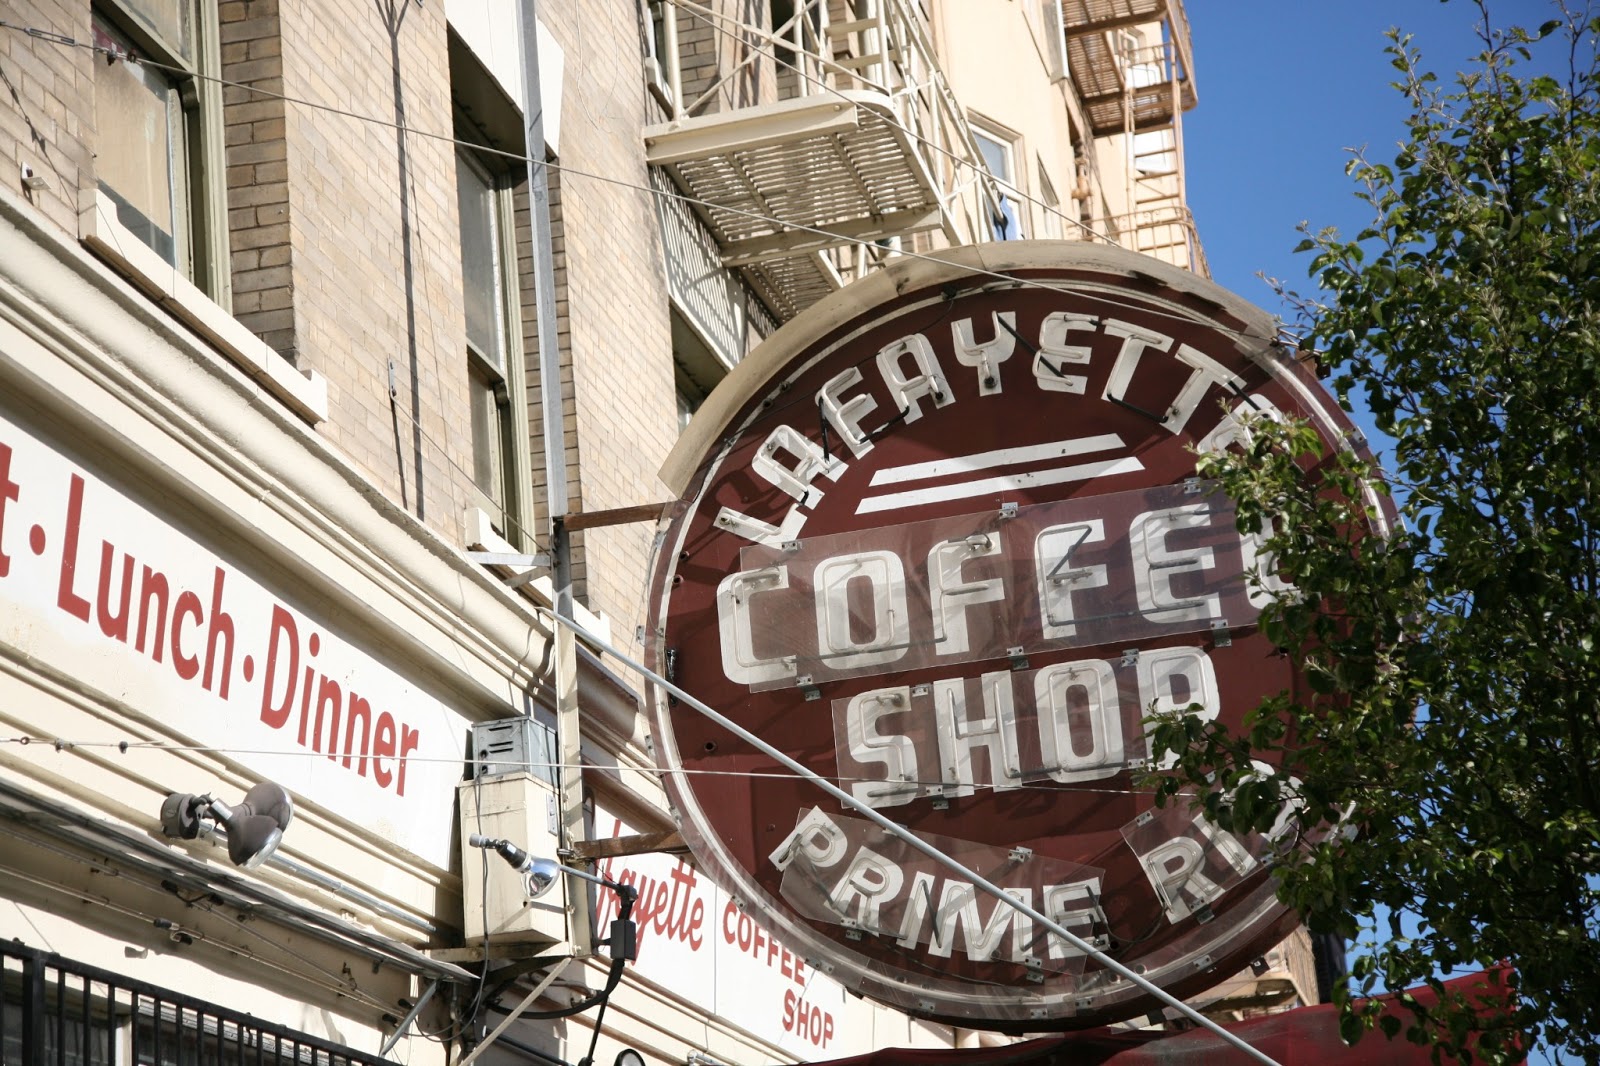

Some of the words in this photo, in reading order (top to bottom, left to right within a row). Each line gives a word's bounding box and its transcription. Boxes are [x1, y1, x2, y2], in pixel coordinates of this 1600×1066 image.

[57, 472, 235, 701] Lunch
[260, 603, 419, 797] Dinner
[845, 646, 1220, 810] SHOP
[722, 899, 806, 988] COFFEE
[768, 805, 1107, 963] PRIME
[782, 988, 834, 1050] SHOP
